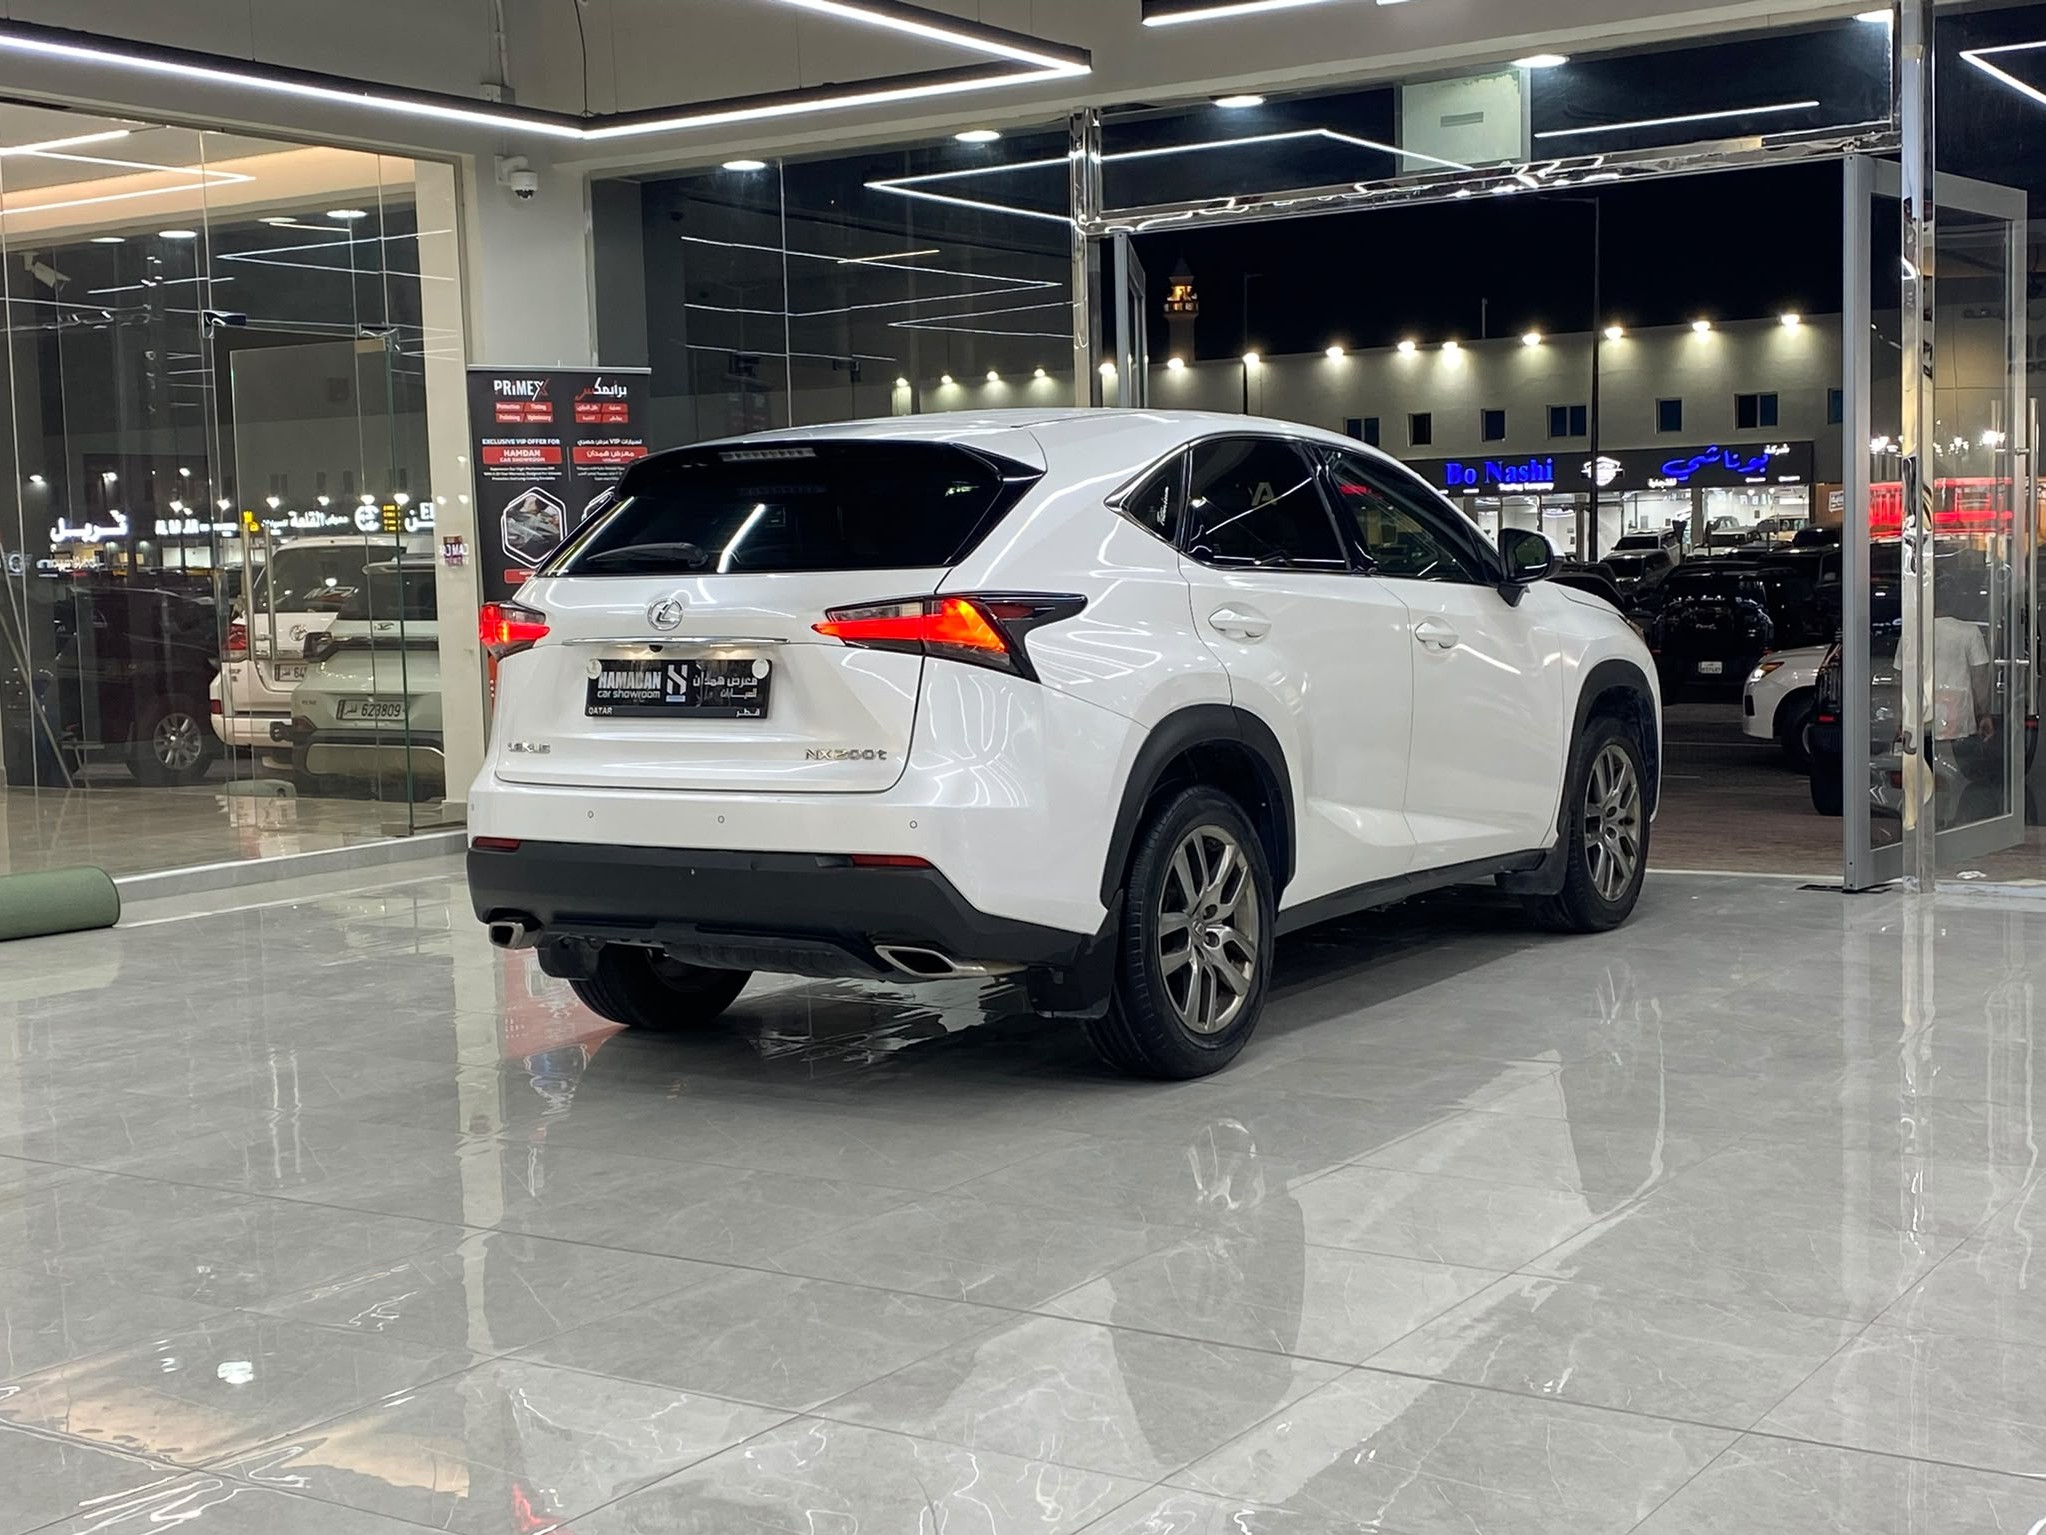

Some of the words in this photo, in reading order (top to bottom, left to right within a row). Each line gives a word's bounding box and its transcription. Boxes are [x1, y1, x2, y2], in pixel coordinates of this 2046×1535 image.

[503, 449, 541, 457] HAMDAN
[1445, 462, 1477, 485] Bo
[1484, 457, 1554, 484] Nashi
[727, 674, 758, 688] معرض
[597, 690, 611, 698] car
[613, 689, 661, 699] showroom
[588, 706, 613, 715] QATAR
[736, 708, 761, 717] قطر
